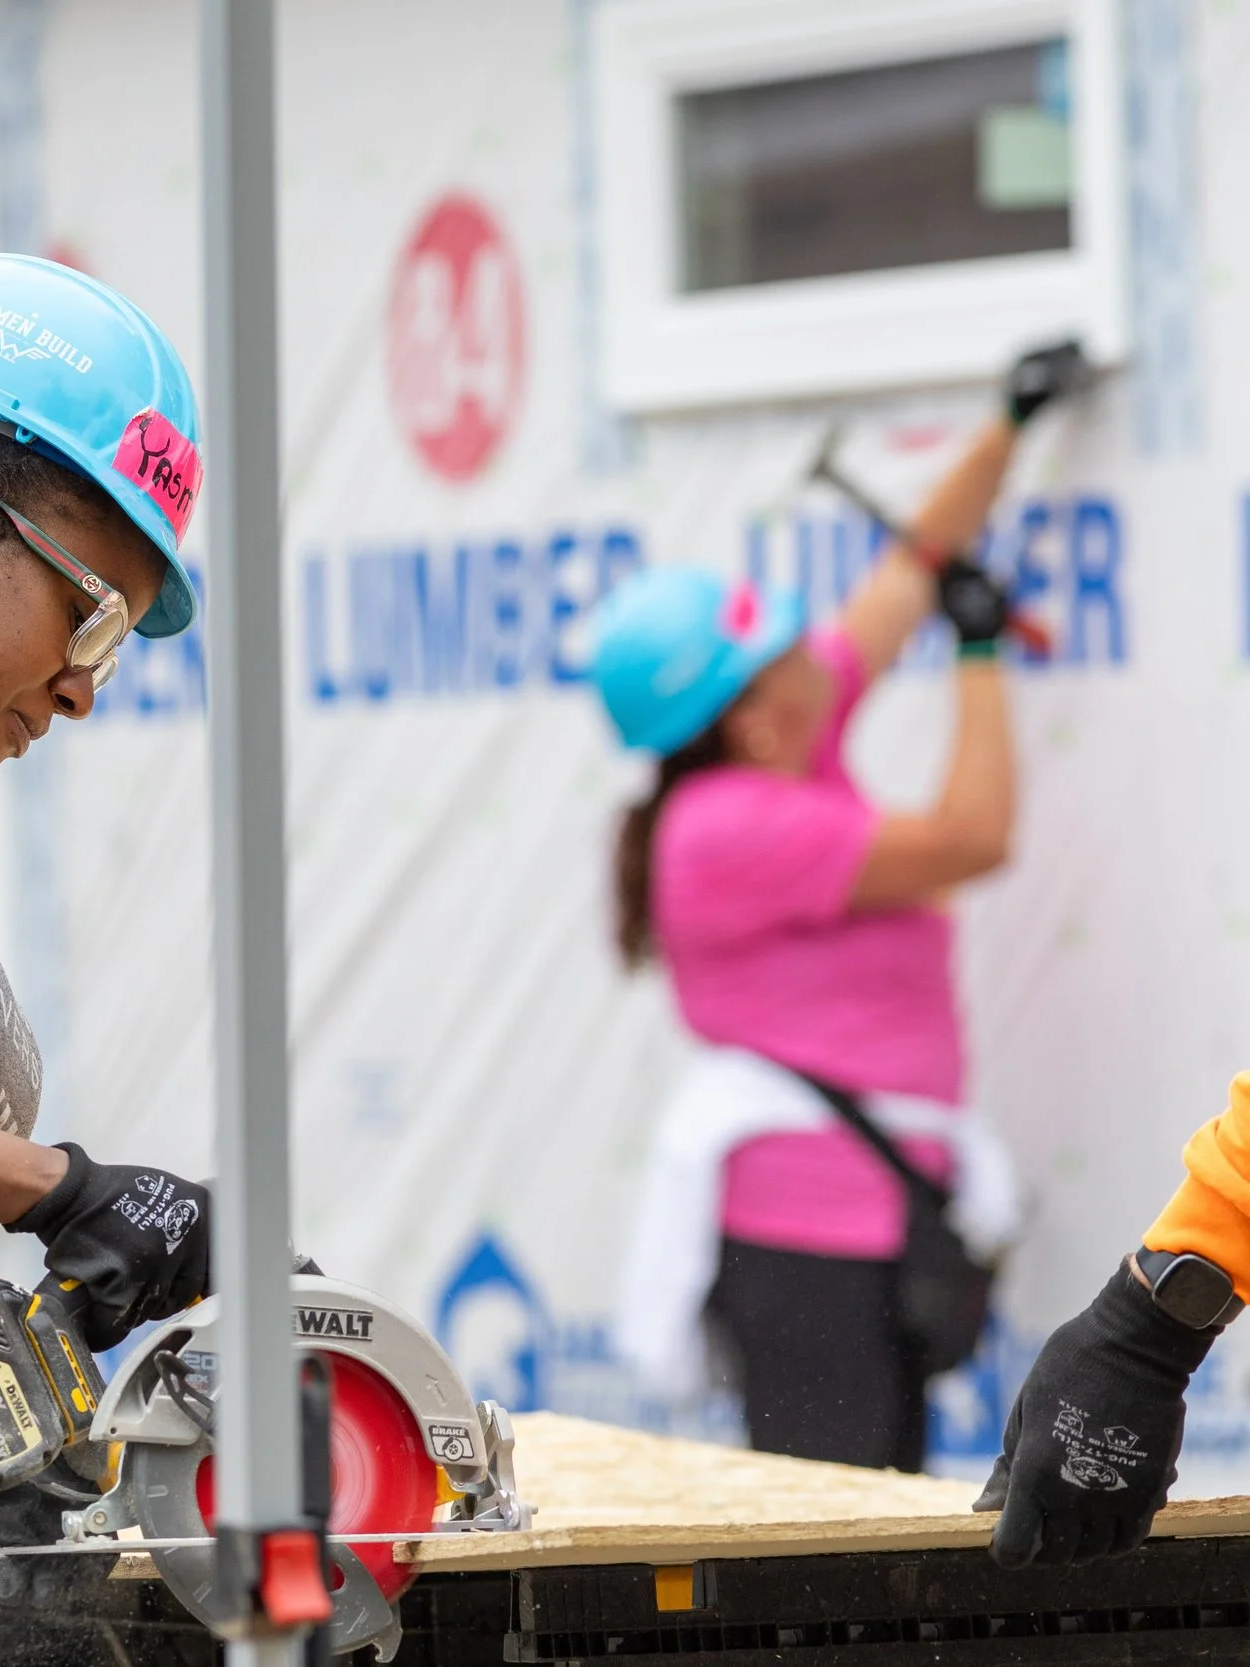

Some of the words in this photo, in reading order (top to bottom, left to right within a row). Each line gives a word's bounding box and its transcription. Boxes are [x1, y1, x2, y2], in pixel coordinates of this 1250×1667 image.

[35, 328, 93, 374] BUILD
[291, 1309, 374, 1338] WALT
[432, 1427, 465, 1436] BRAKE
